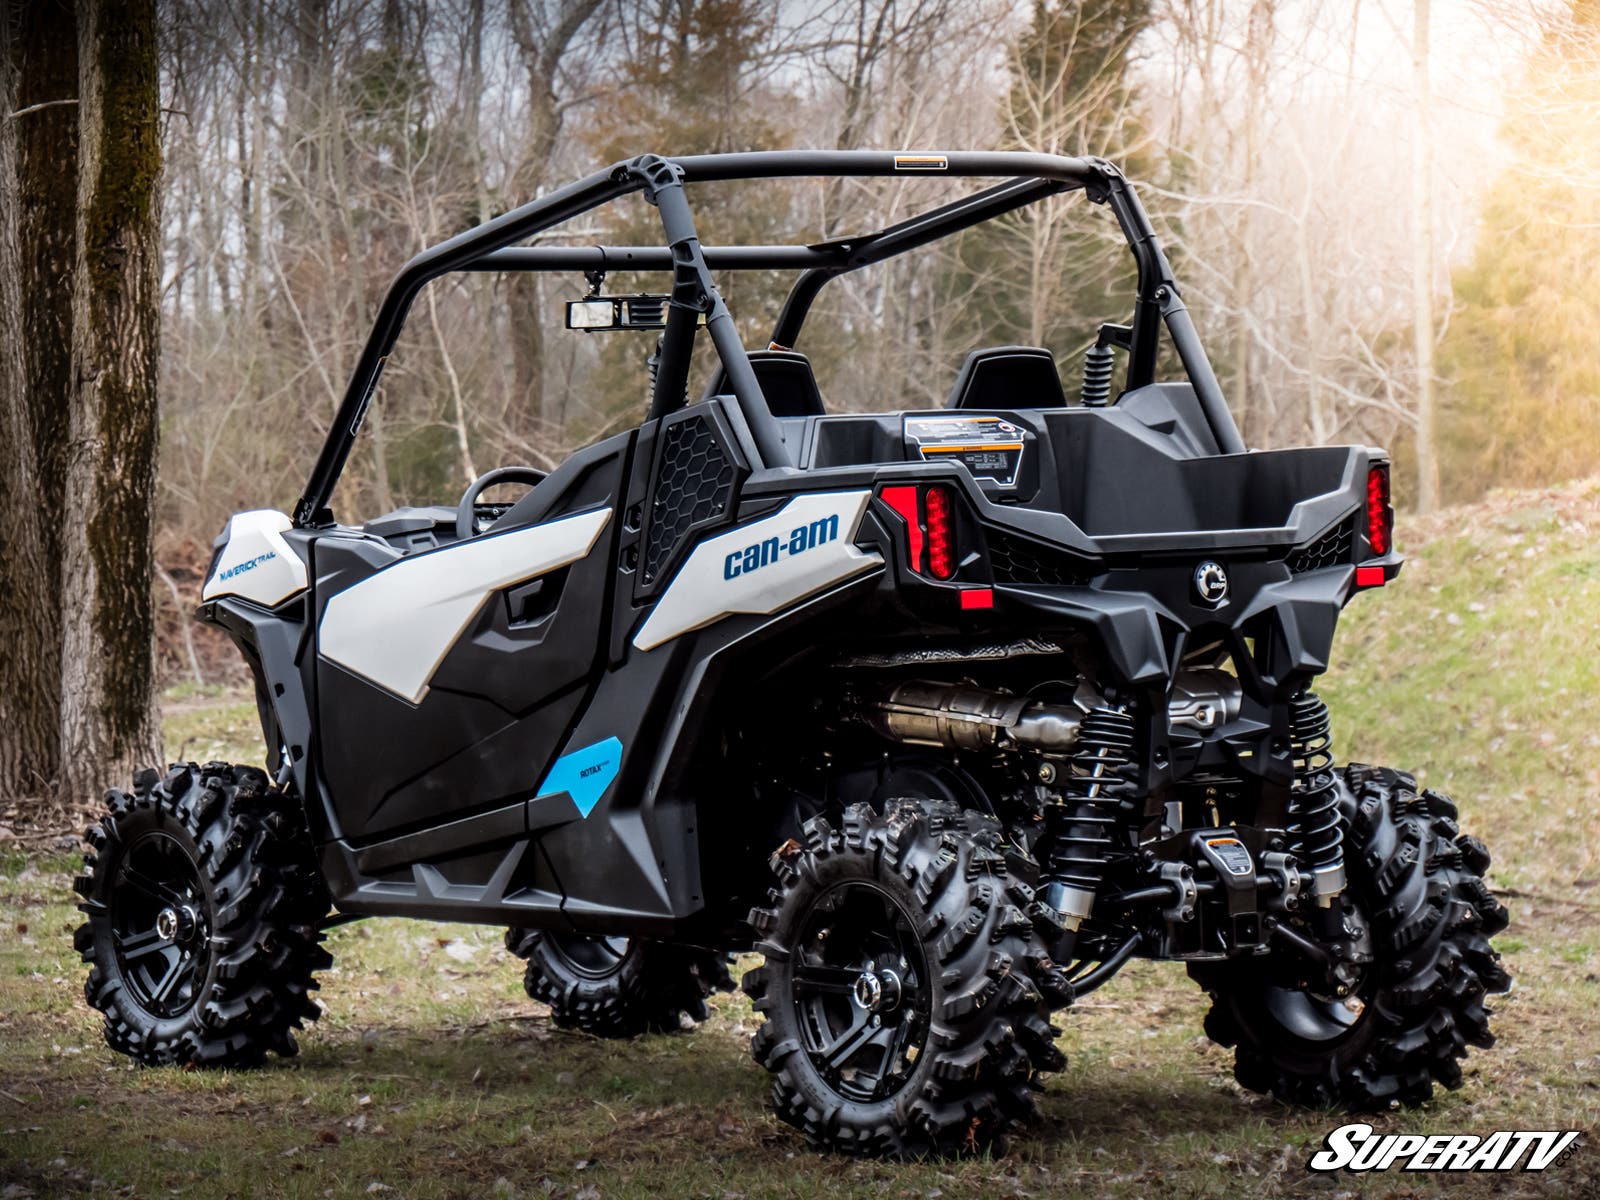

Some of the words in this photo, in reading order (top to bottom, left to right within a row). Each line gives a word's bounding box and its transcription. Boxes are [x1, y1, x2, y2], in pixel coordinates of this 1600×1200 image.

[724, 514, 838, 580] can-am
[220, 559, 257, 581] MAVERICK
[257, 552, 276, 562] TRAIL
[580, 764, 602, 779] ROTAX
